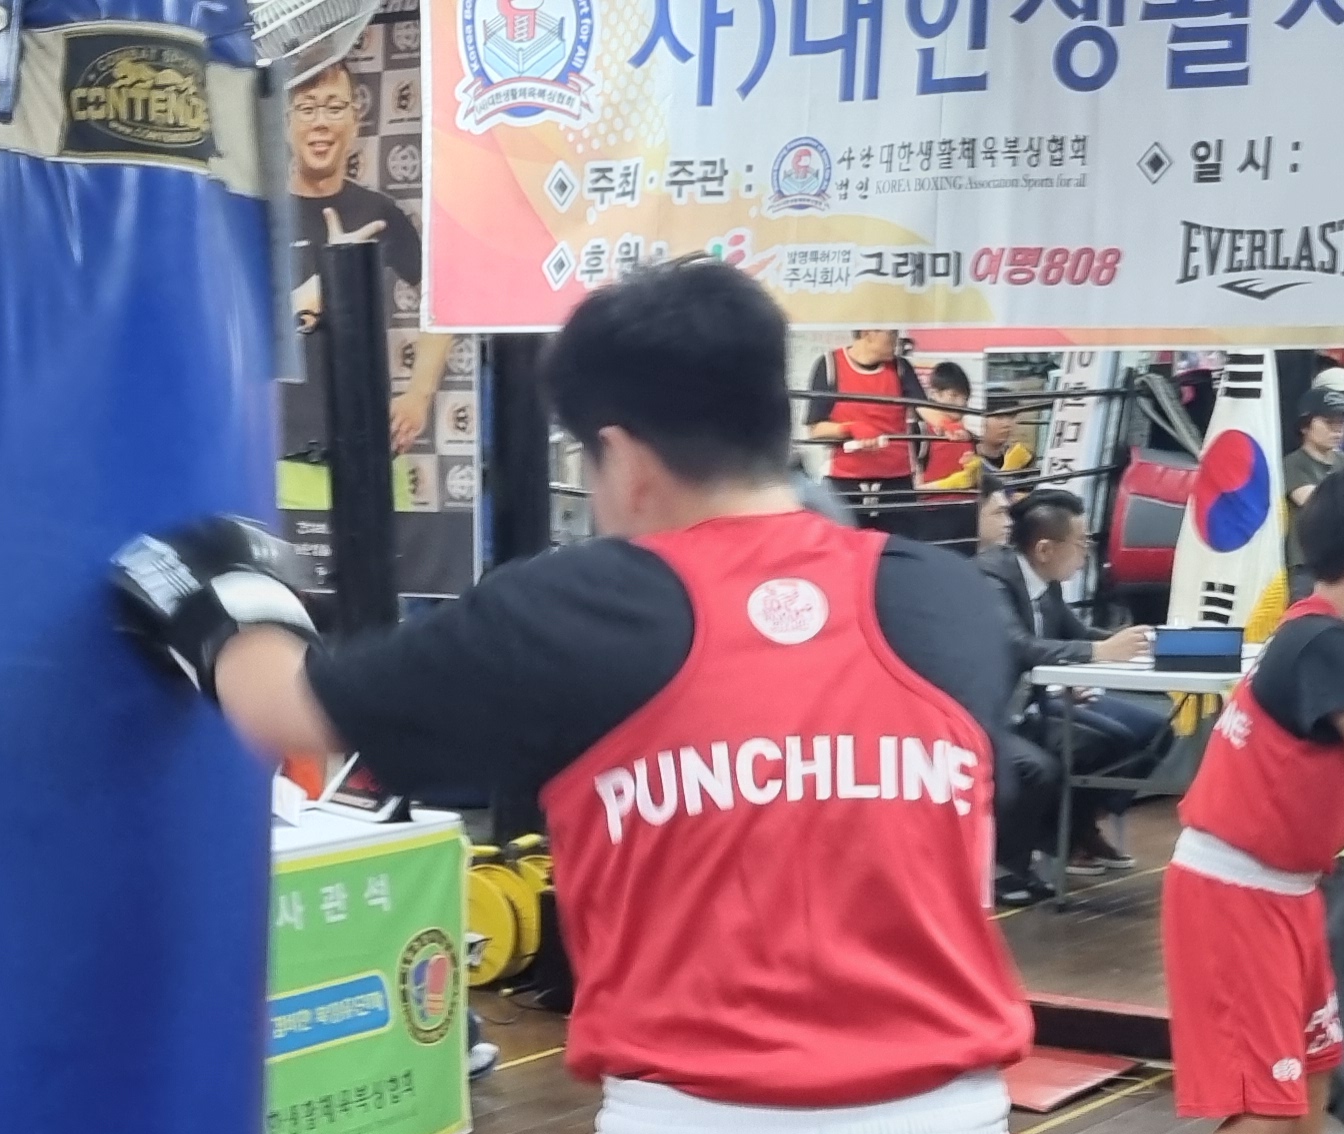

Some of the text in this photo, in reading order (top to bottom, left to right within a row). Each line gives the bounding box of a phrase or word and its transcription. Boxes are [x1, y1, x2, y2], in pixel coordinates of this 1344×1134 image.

[571, 46, 588, 69] All
[878, 134, 1090, 174] 대한생활체육복싱협회
[875, 177, 912, 195] KOREA
[913, 175, 963, 192] BOXING
[1056, 171, 1072, 188] for
[1073, 171, 1088, 188] all
[783, 266, 852, 288] 주식회사
[855, 250, 963, 287] 그래미
[969, 246, 1122, 287] 여명808
[594, 733, 979, 847] PUNCHLINE
